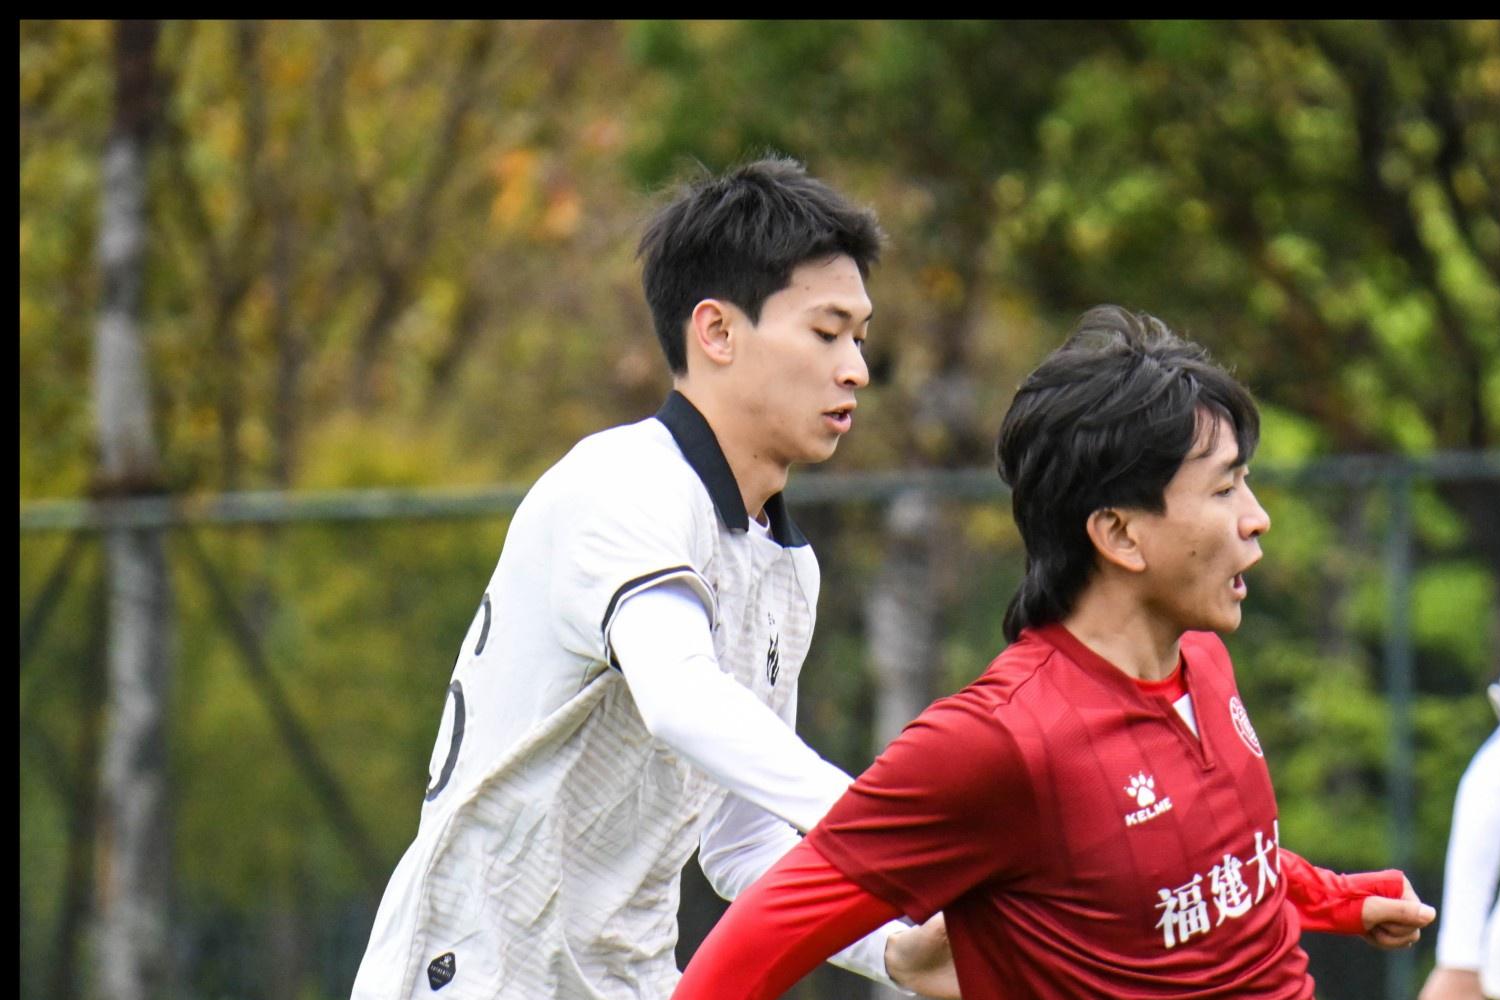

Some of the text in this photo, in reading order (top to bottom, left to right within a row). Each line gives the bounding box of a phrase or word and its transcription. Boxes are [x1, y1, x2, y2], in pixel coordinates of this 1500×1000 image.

[1124, 796, 1173, 827] KELME
[1154, 818, 1282, 949] 福建大
